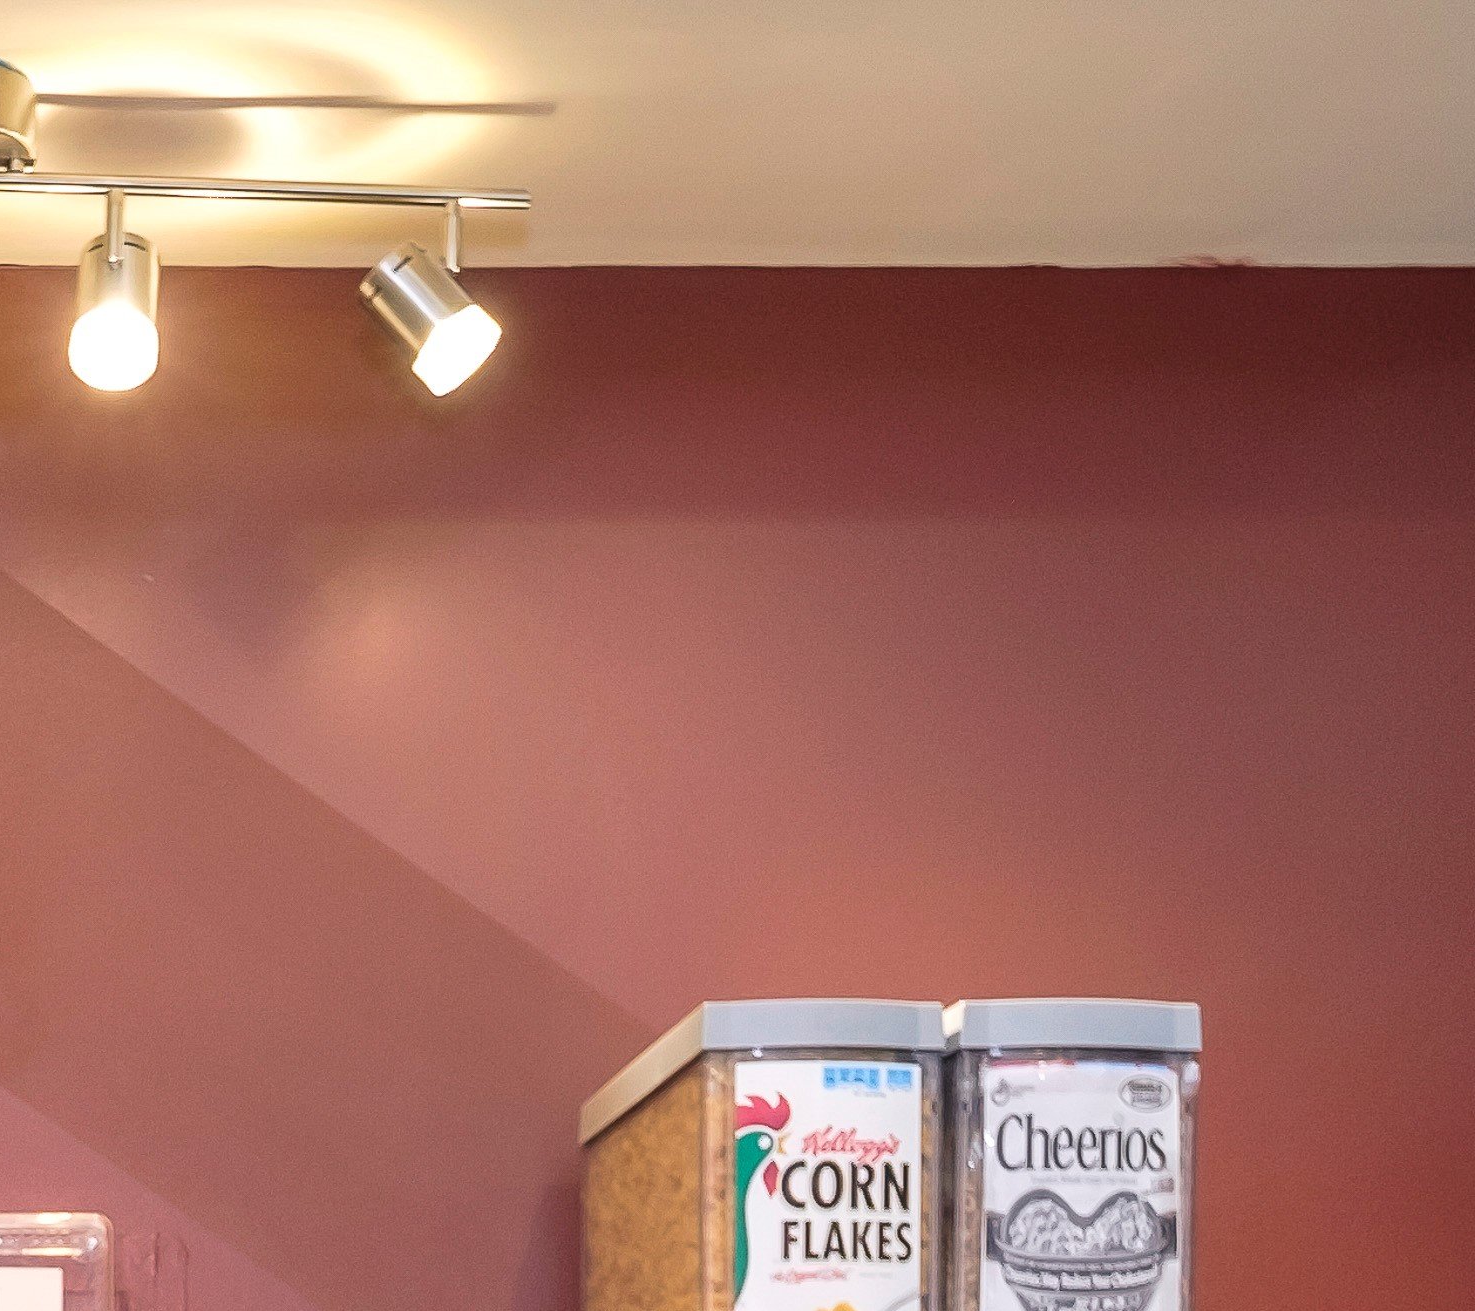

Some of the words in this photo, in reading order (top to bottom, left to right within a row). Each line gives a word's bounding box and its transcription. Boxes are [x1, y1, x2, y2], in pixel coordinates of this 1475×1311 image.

[996, 1112, 1168, 1173] Cheerios
[781, 1160, 911, 1211] CORN
[782, 1220, 912, 1261] FLAKES
